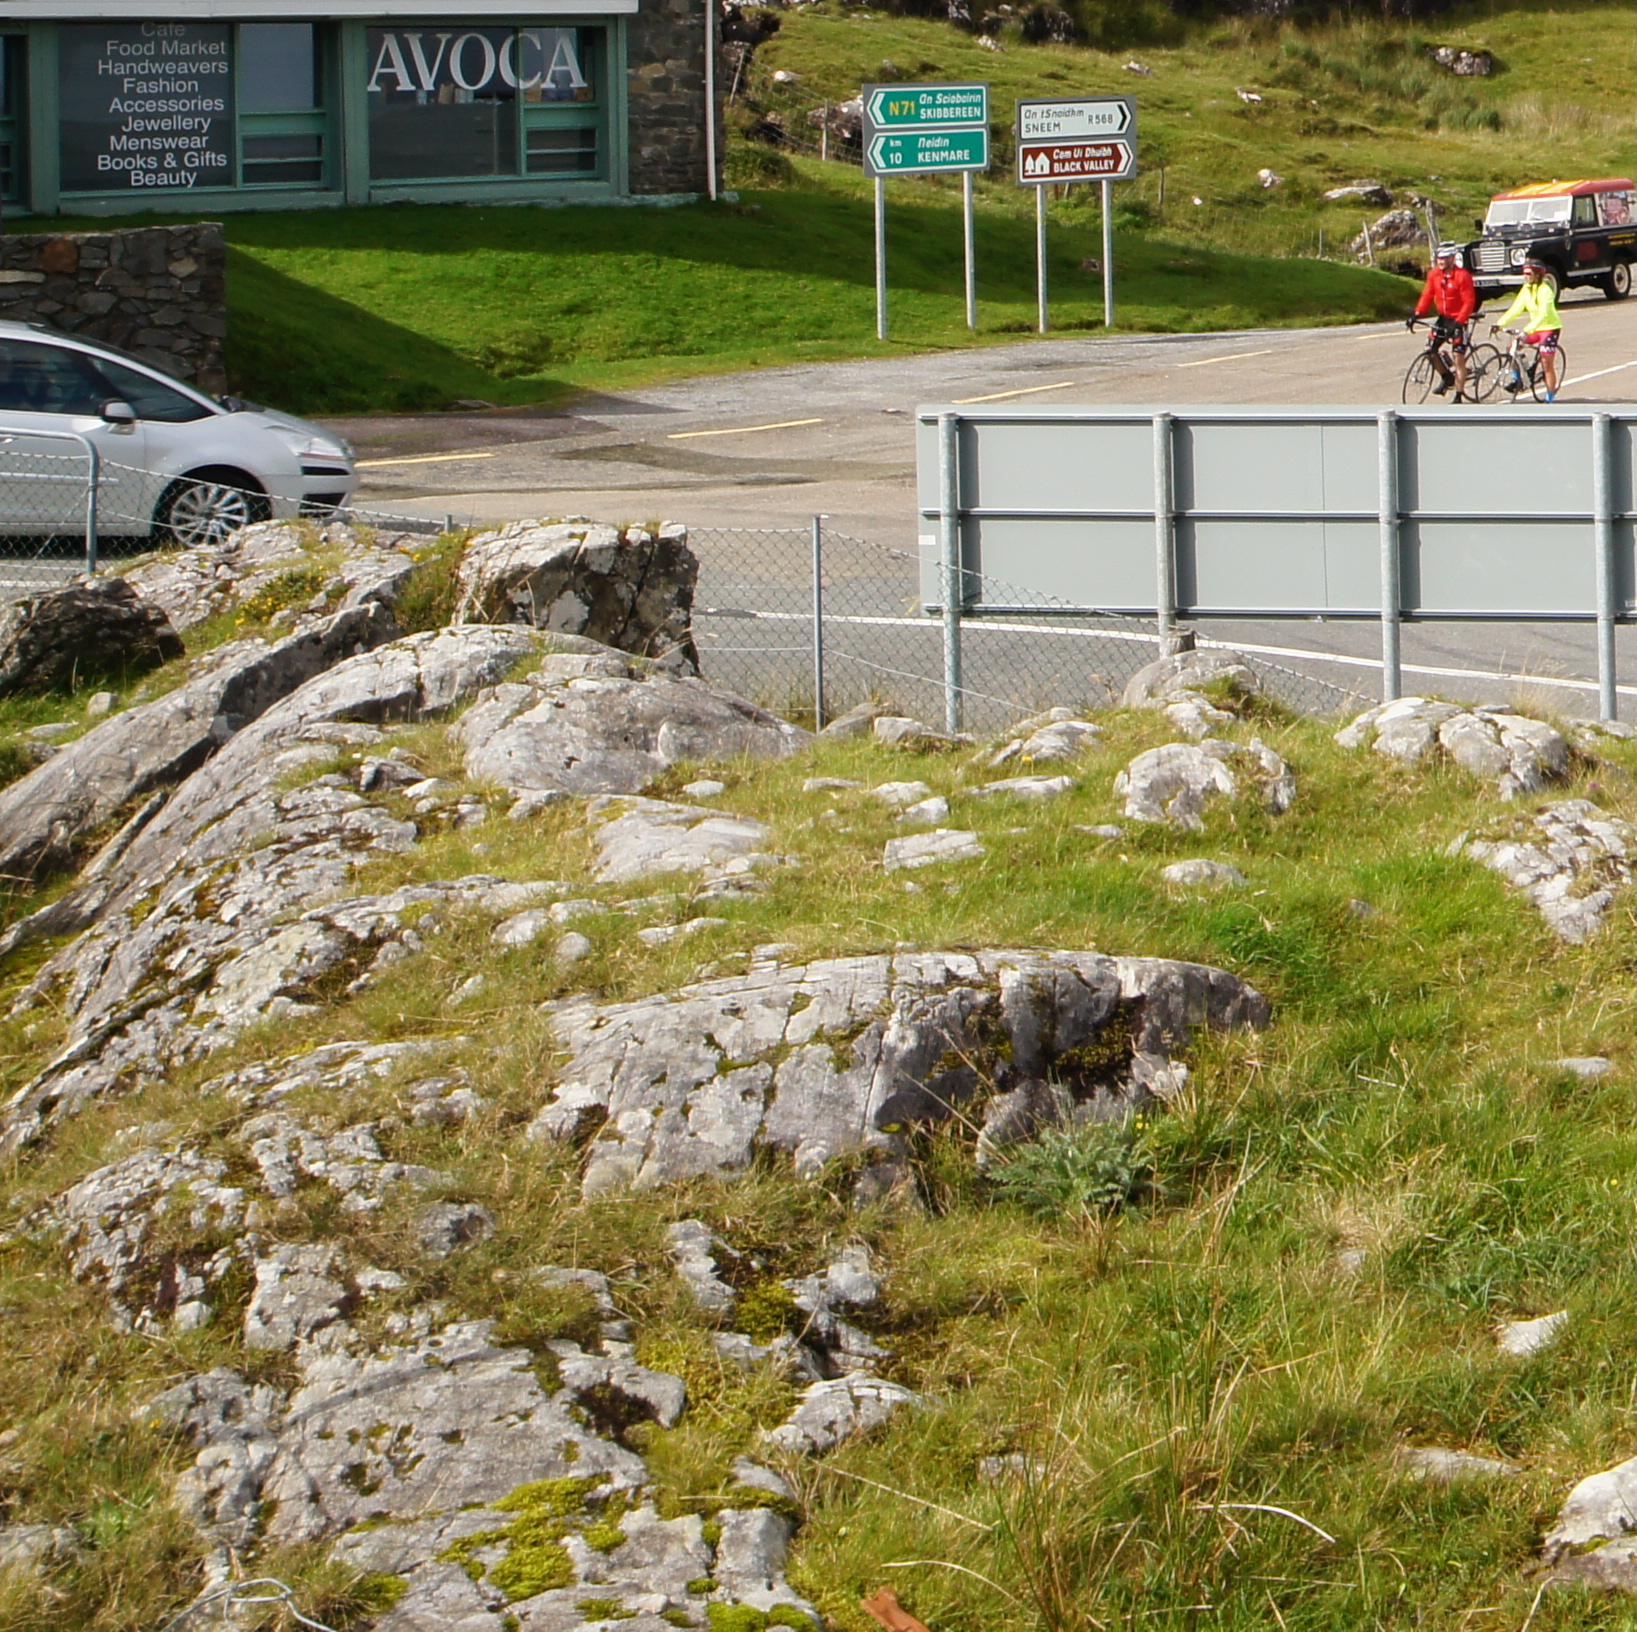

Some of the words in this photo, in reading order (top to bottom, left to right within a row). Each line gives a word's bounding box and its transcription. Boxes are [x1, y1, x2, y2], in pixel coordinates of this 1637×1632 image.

[106, 40, 155, 56] Food
[161, 40, 226, 55] Market
[98, 59, 228, 75] Handweavers
[367, 33, 588, 92] AVOCA
[123, 77, 199, 94] Fashion
[109, 96, 225, 113] Accessories
[919, 93, 933, 105] An
[889, 100, 916, 116] N71
[920, 106, 981, 119] SKIBBEREEN
[1024, 109, 1037, 119] An
[122, 115, 211, 133] Jewellery
[1025, 122, 1061, 133] SNEEM
[110, 135, 209, 151] Menswear
[890, 139, 902, 147] km
[97, 154, 158, 171] Books
[163, 152, 177, 168] &
[184, 151, 227, 167] Gifts
[889, 152, 902, 164] 10
[918, 149, 970, 163] KENMARE
[1053, 161, 1082, 173] BLACK
[1083, 159, 1115, 171] VALLEY
[130, 169, 197, 188] Beauty
